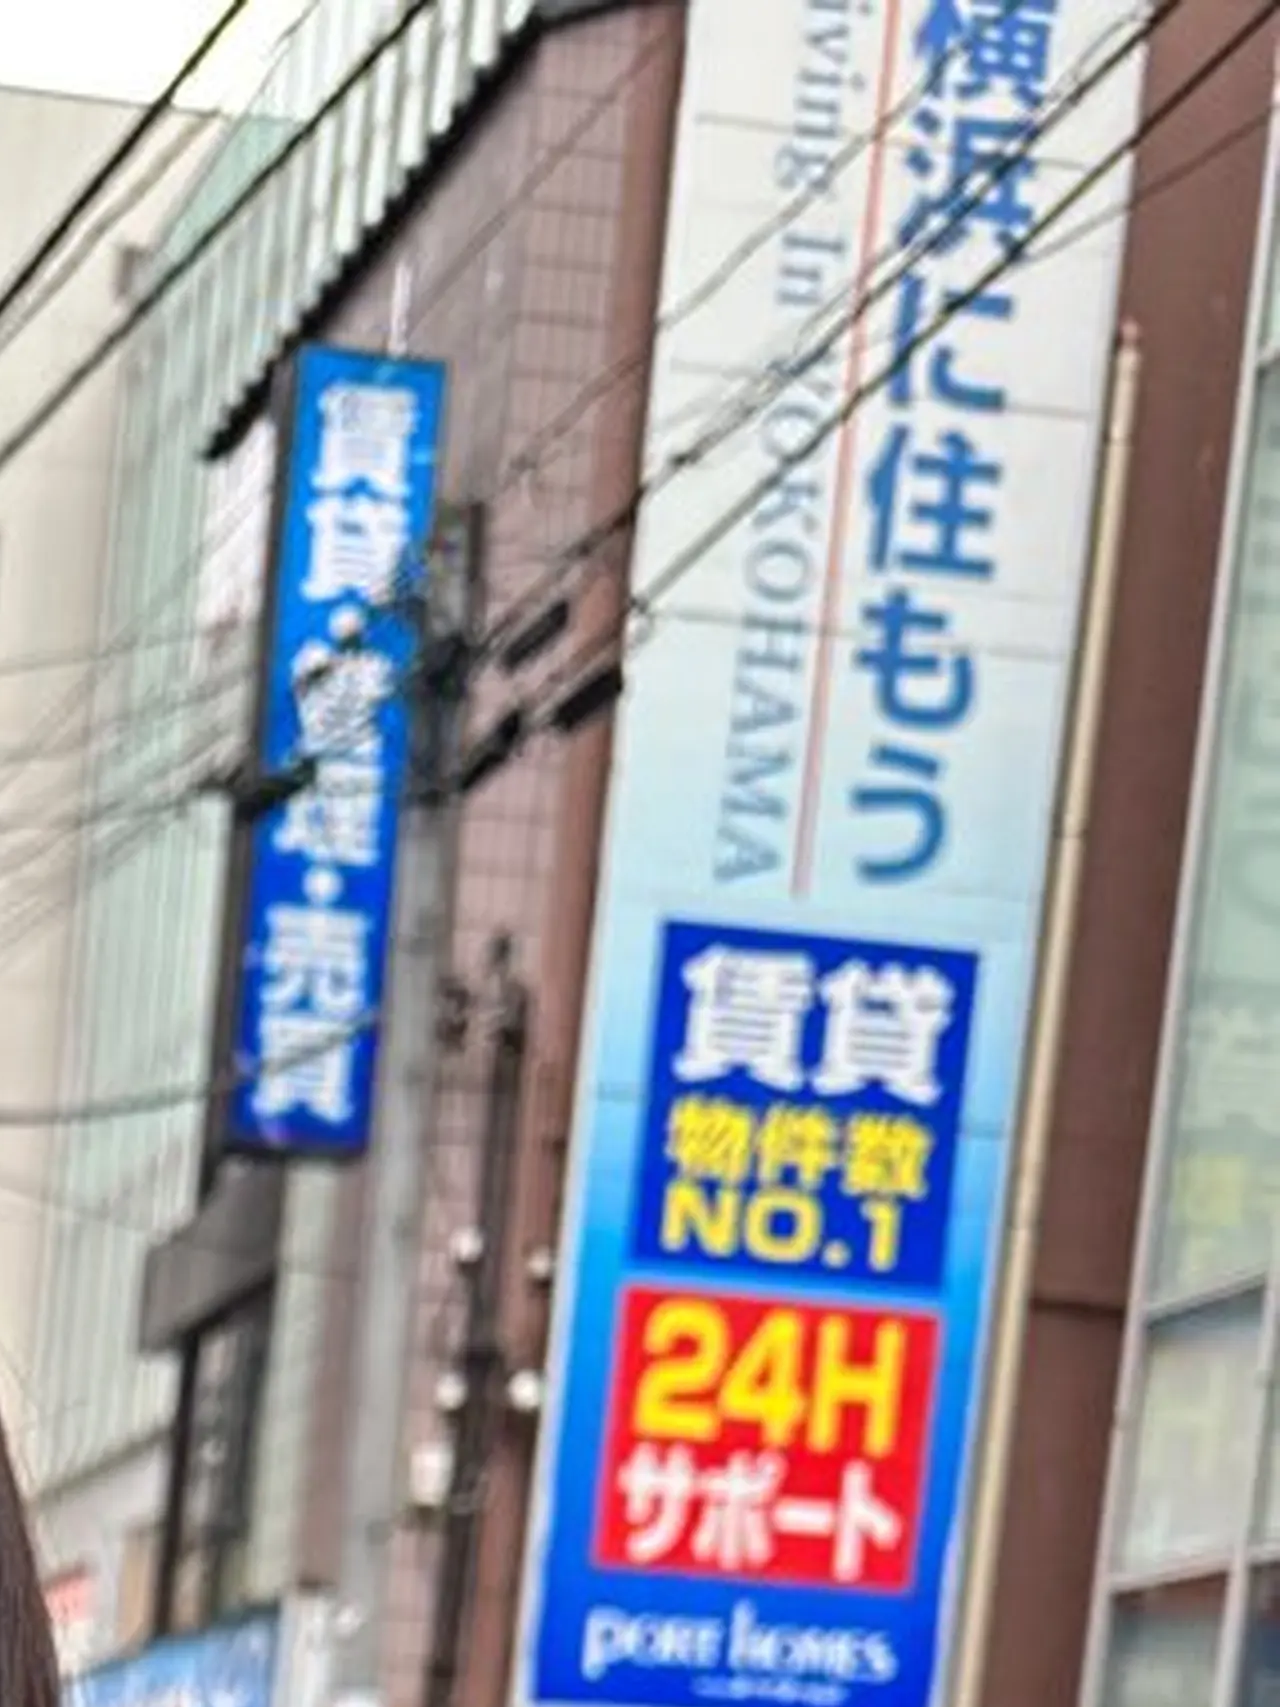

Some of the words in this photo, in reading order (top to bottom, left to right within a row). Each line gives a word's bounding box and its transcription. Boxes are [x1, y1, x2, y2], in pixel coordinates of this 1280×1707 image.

[775, 0, 864, 190] iving
[672, 944, 954, 1105] 賃貸
[664, 1094, 933, 1202] 物件数
[660, 1178, 904, 1272] NO.1
[633, 1296, 908, 1462] 24H
[616, 1440, 904, 1583] サポート
